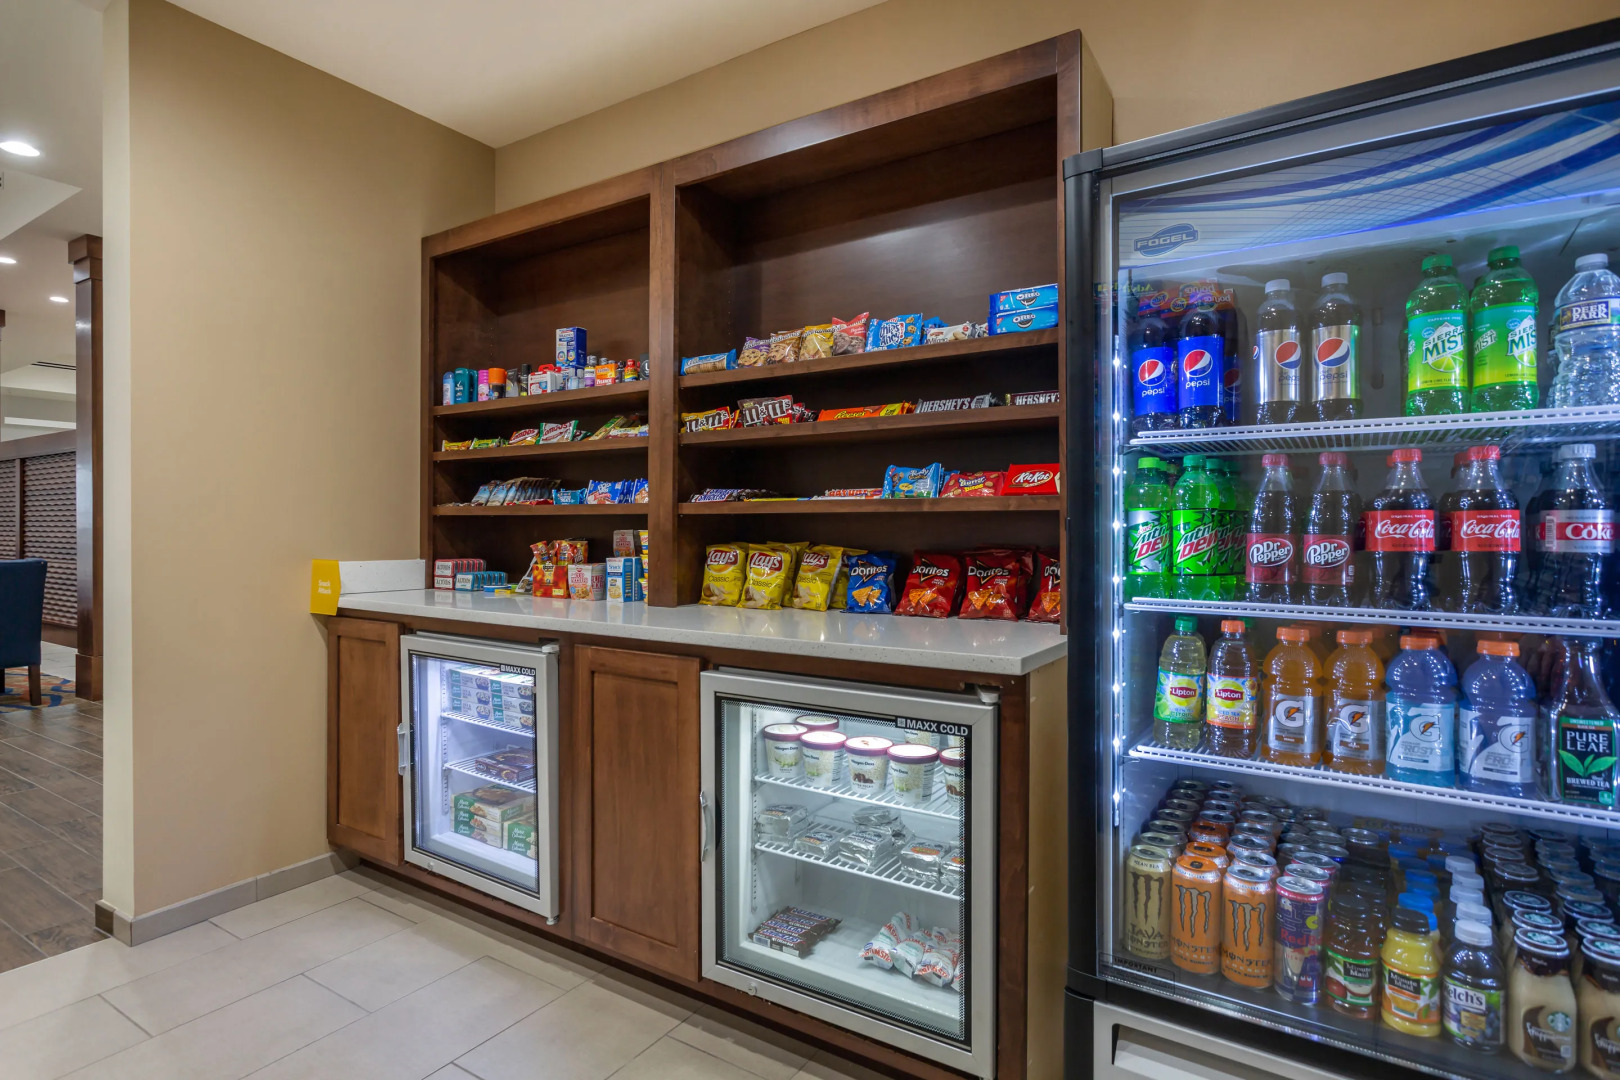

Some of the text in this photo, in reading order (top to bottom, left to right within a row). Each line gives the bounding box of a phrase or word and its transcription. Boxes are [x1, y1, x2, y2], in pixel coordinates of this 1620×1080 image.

[1137, 234, 1193, 249] FOGEL
[1016, 291, 1040, 301] OREO
[1572, 303, 1607, 315] DEER
[1013, 313, 1036, 323] OREO
[1572, 310, 1607, 322] PARK
[1424, 332, 1464, 362] MIST
[1320, 372, 1348, 381] pepsi
[1185, 379, 1210, 389] pepsi
[1142, 387, 1165, 398] pepsi
[921, 397, 971, 413] HERSHEY'S
[1375, 519, 1434, 539] Coca-Cola
[1461, 519, 1520, 539] Coca-Cola
[1264, 541, 1280, 553] Dr
[1320, 543, 1337, 552] Dr
[707, 550, 738, 566] Lay's
[1253, 545, 1291, 564] Pepper
[1311, 545, 1347, 565] Pepper
[750, 552, 782, 572] Lay's
[851, 566, 887, 577] Doritos
[913, 566, 950, 577] Doritos
[967, 566, 1010, 577] Doritos
[708, 575, 729, 583] Classic
[505, 665, 535, 676] MAXX COLD
[1172, 688, 1195, 697] Lipton
[1217, 690, 1241, 699] Lipton
[1275, 700, 1304, 727] G
[906, 719, 968, 737] MAXX COLD
[1566, 731, 1608, 743] PURE
[1566, 777, 1610, 789] BREWED TEA
[1280, 928, 1307, 946] Red
[1349, 970, 1369, 978] Maid
